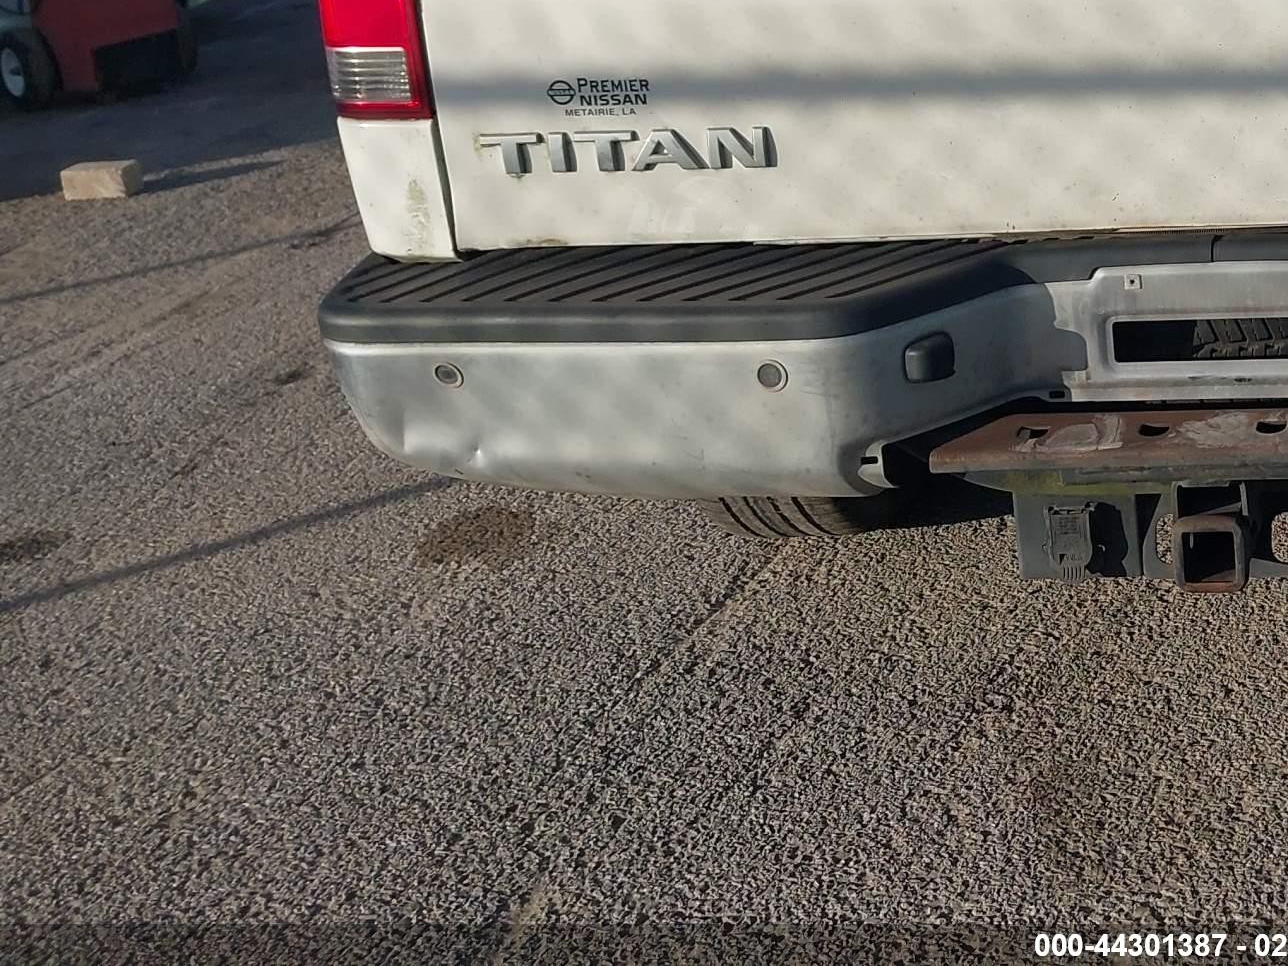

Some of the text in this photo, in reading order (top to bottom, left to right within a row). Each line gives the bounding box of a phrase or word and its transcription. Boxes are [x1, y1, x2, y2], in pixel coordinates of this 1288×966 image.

[579, 94, 648, 106] NISSAN
[565, 108, 636, 117] METAIRIE, LA
[479, 126, 778, 174] TITAN
